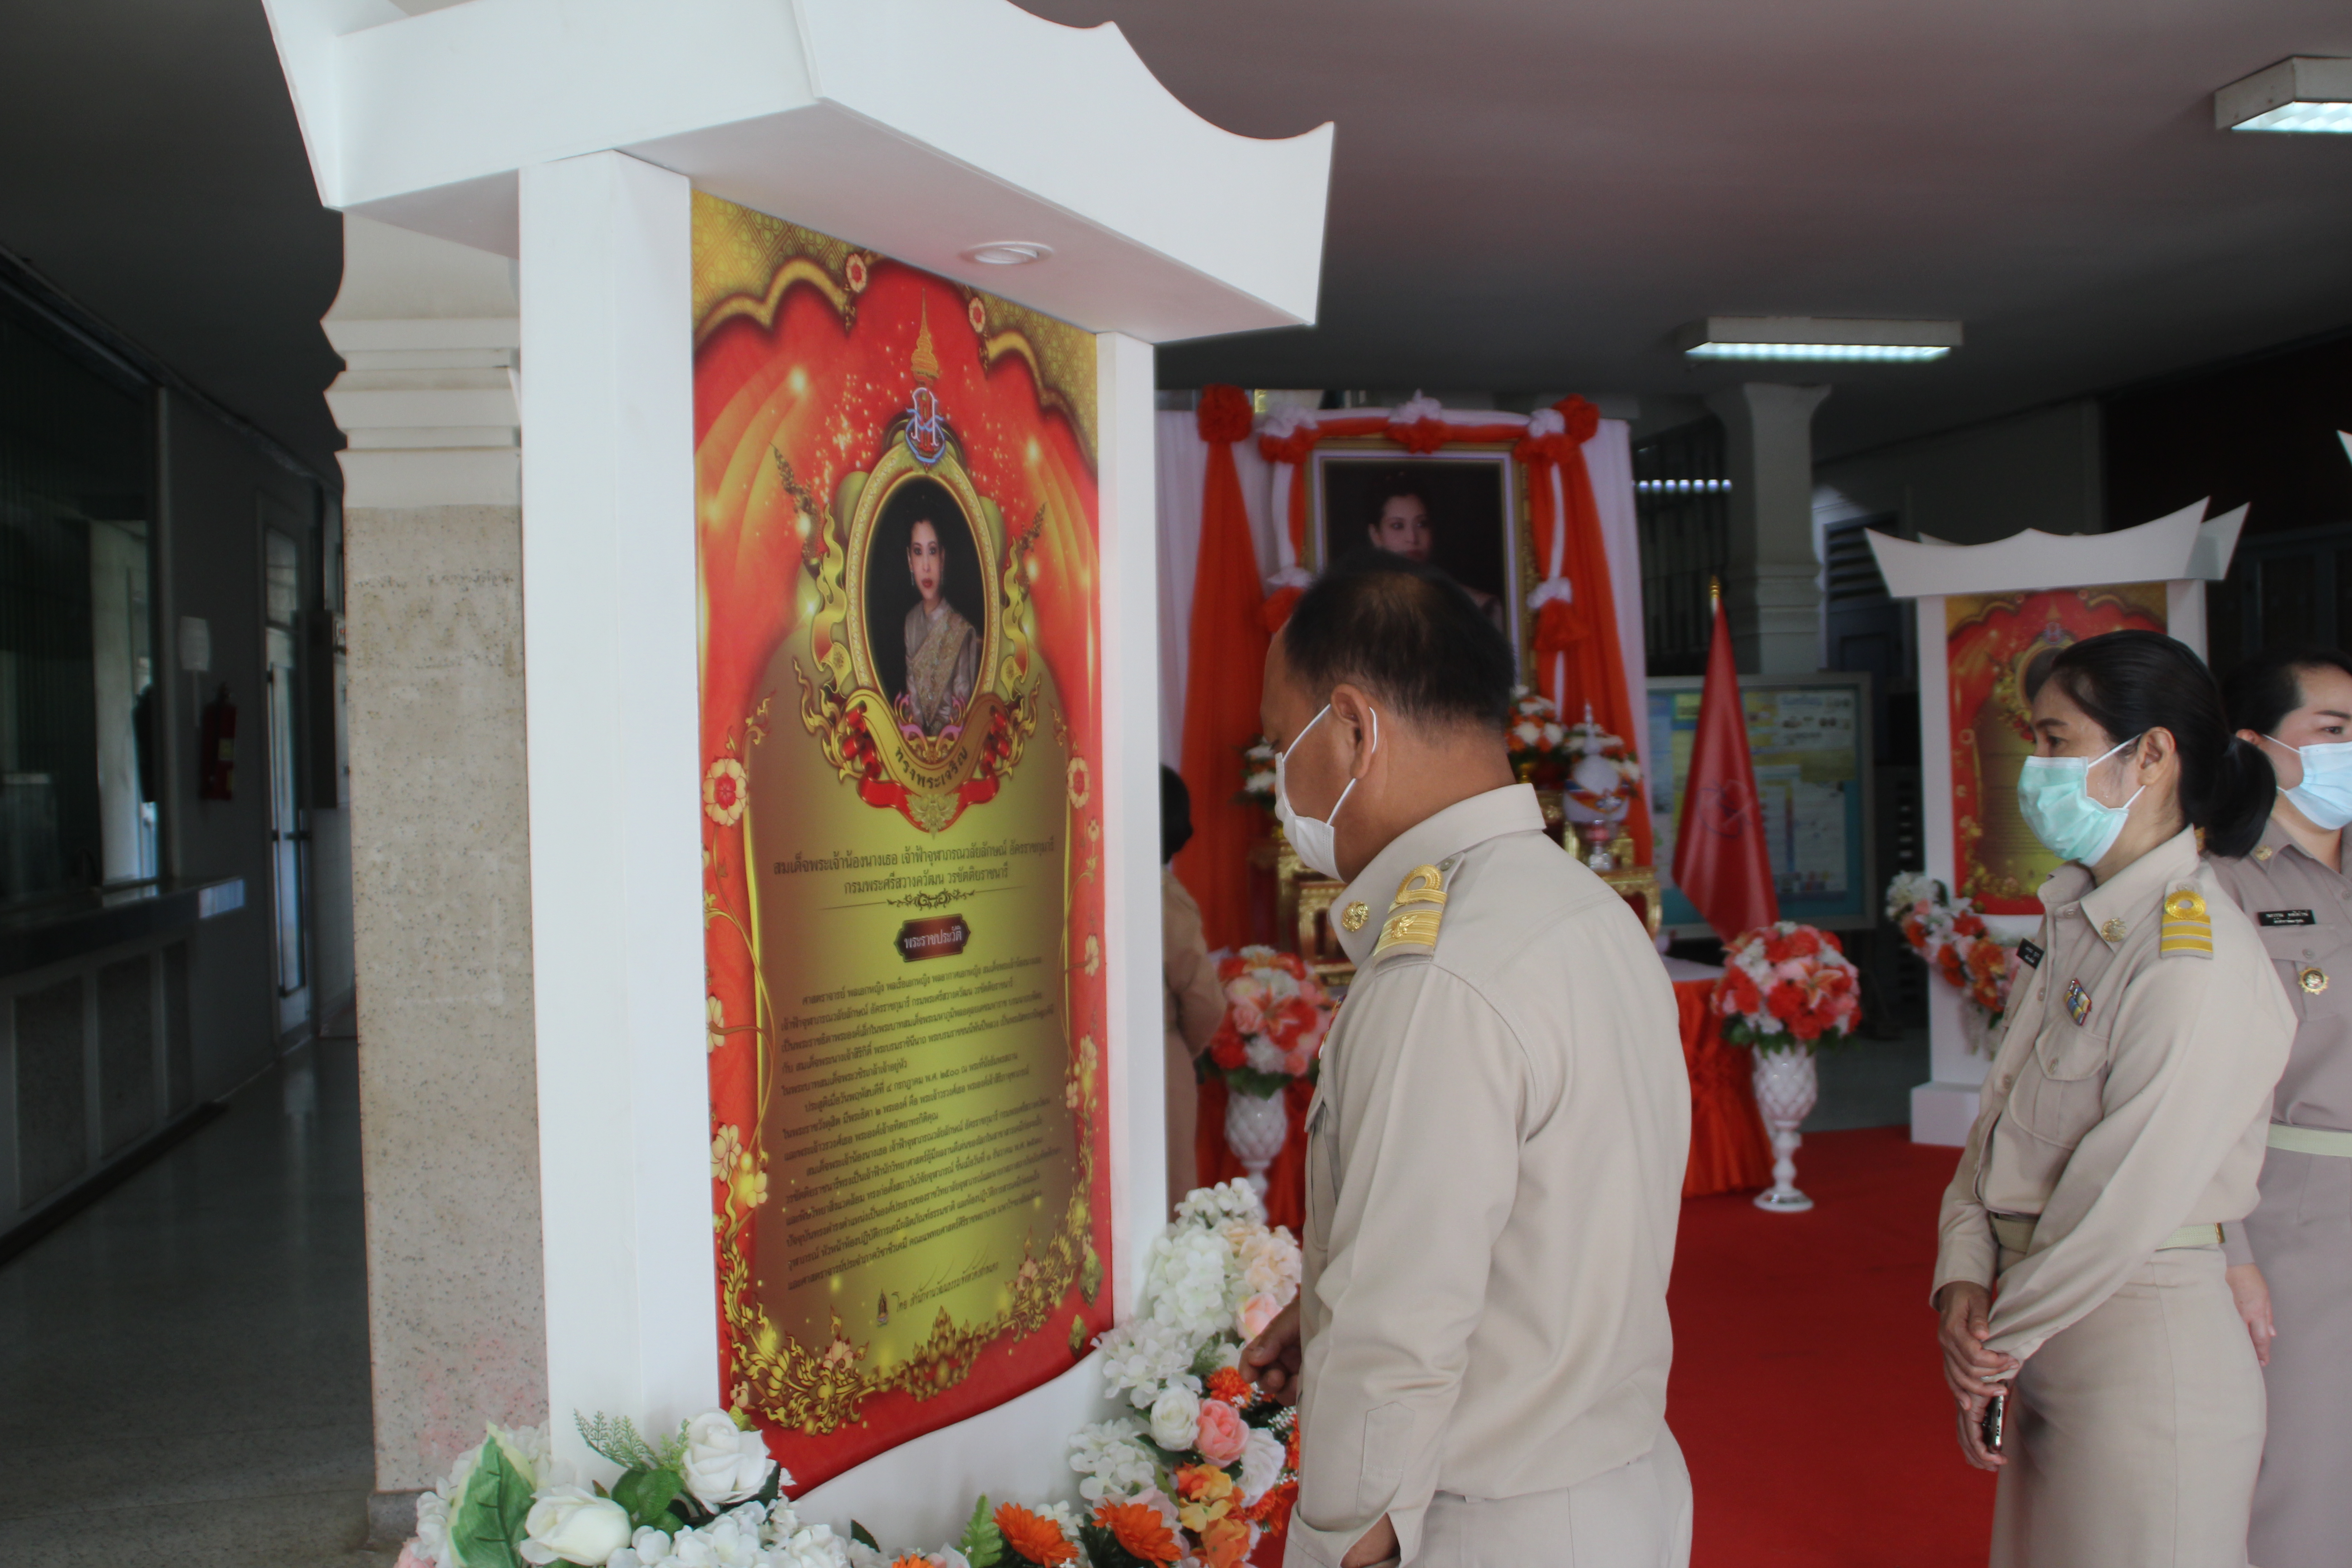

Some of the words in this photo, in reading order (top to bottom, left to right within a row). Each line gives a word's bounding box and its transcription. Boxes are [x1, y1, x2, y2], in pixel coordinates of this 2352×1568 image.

[896, 746, 968, 789] ทรงพระเจริญ
[774, 850, 897, 875] สมเด็จพระเจ้าน้องนางเธอ
[901, 839, 1006, 866] เจ้าฟ้าจุฬาภรณวลัยลักษณ์
[1009, 835, 1054, 857] อัครราชกุมารี
[844, 869, 944, 894] กรมพระศรีสวางควัฒน
[947, 861, 1008, 883] วรขัตติยราชนารี
[904, 925, 961, 948] พระราชประวัติ
[802, 985, 845, 1005] ศาสตราจารย์
[848, 981, 884, 997] พลเอกหญิง
[886, 973, 930, 991] พลเรือเอกหญิง
[932, 965, 980, 983] พลอากาศเอกหญิง
[871, 996, 909, 1014] อัครราชกุมารี
[912, 986, 972, 1006] กรมพระศรีสวางควัฒน
[975, 976, 1013, 994] วรขัตติยราชนารี
[782, 1062, 793, 1073] กับ
[796, 1041, 872, 1071] สมเด็จพระนางเจ้าสิริกิติ์
[874, 1034, 926, 1054] พระบรมราชินีนาถ
[928, 1019, 999, 1043] พระบรมราชชนนีพันปีหลวง
[894, 1076, 923, 1091] กรกฎาคม
[926, 1073, 938, 1082] พ.ศ.
[940, 1068, 960, 1079] ๒๕๐๐
[843, 1107, 873, 1124] มีพระธิดา
[875, 1107, 881, 1116] ๒
[882, 1095, 906, 1113] พระองค์
[909, 1094, 918, 1107] คือ
[920, 1083, 965, 1103] พระเจ้าวรวงศ์เธอ
[784, 1133, 853, 1161] และพระเจ้าวรวงศ์เธอ
[806, 1146, 887, 1176] สมเด็จพระเจ้าน้องนางเธอ
[889, 1119, 963, 1152] เจ้าฟ้าจุฬาภรณวลัยลักษณ์
[965, 1109, 998, 1130] อัครราชกุมารี
[993, 1147, 1013, 1158] ธันวาคม
[909, 1207, 996, 1246] คณะแพทยศาสตร์ศิริราชพยาบาล
[891, 1291, 907, 1312] โดย
